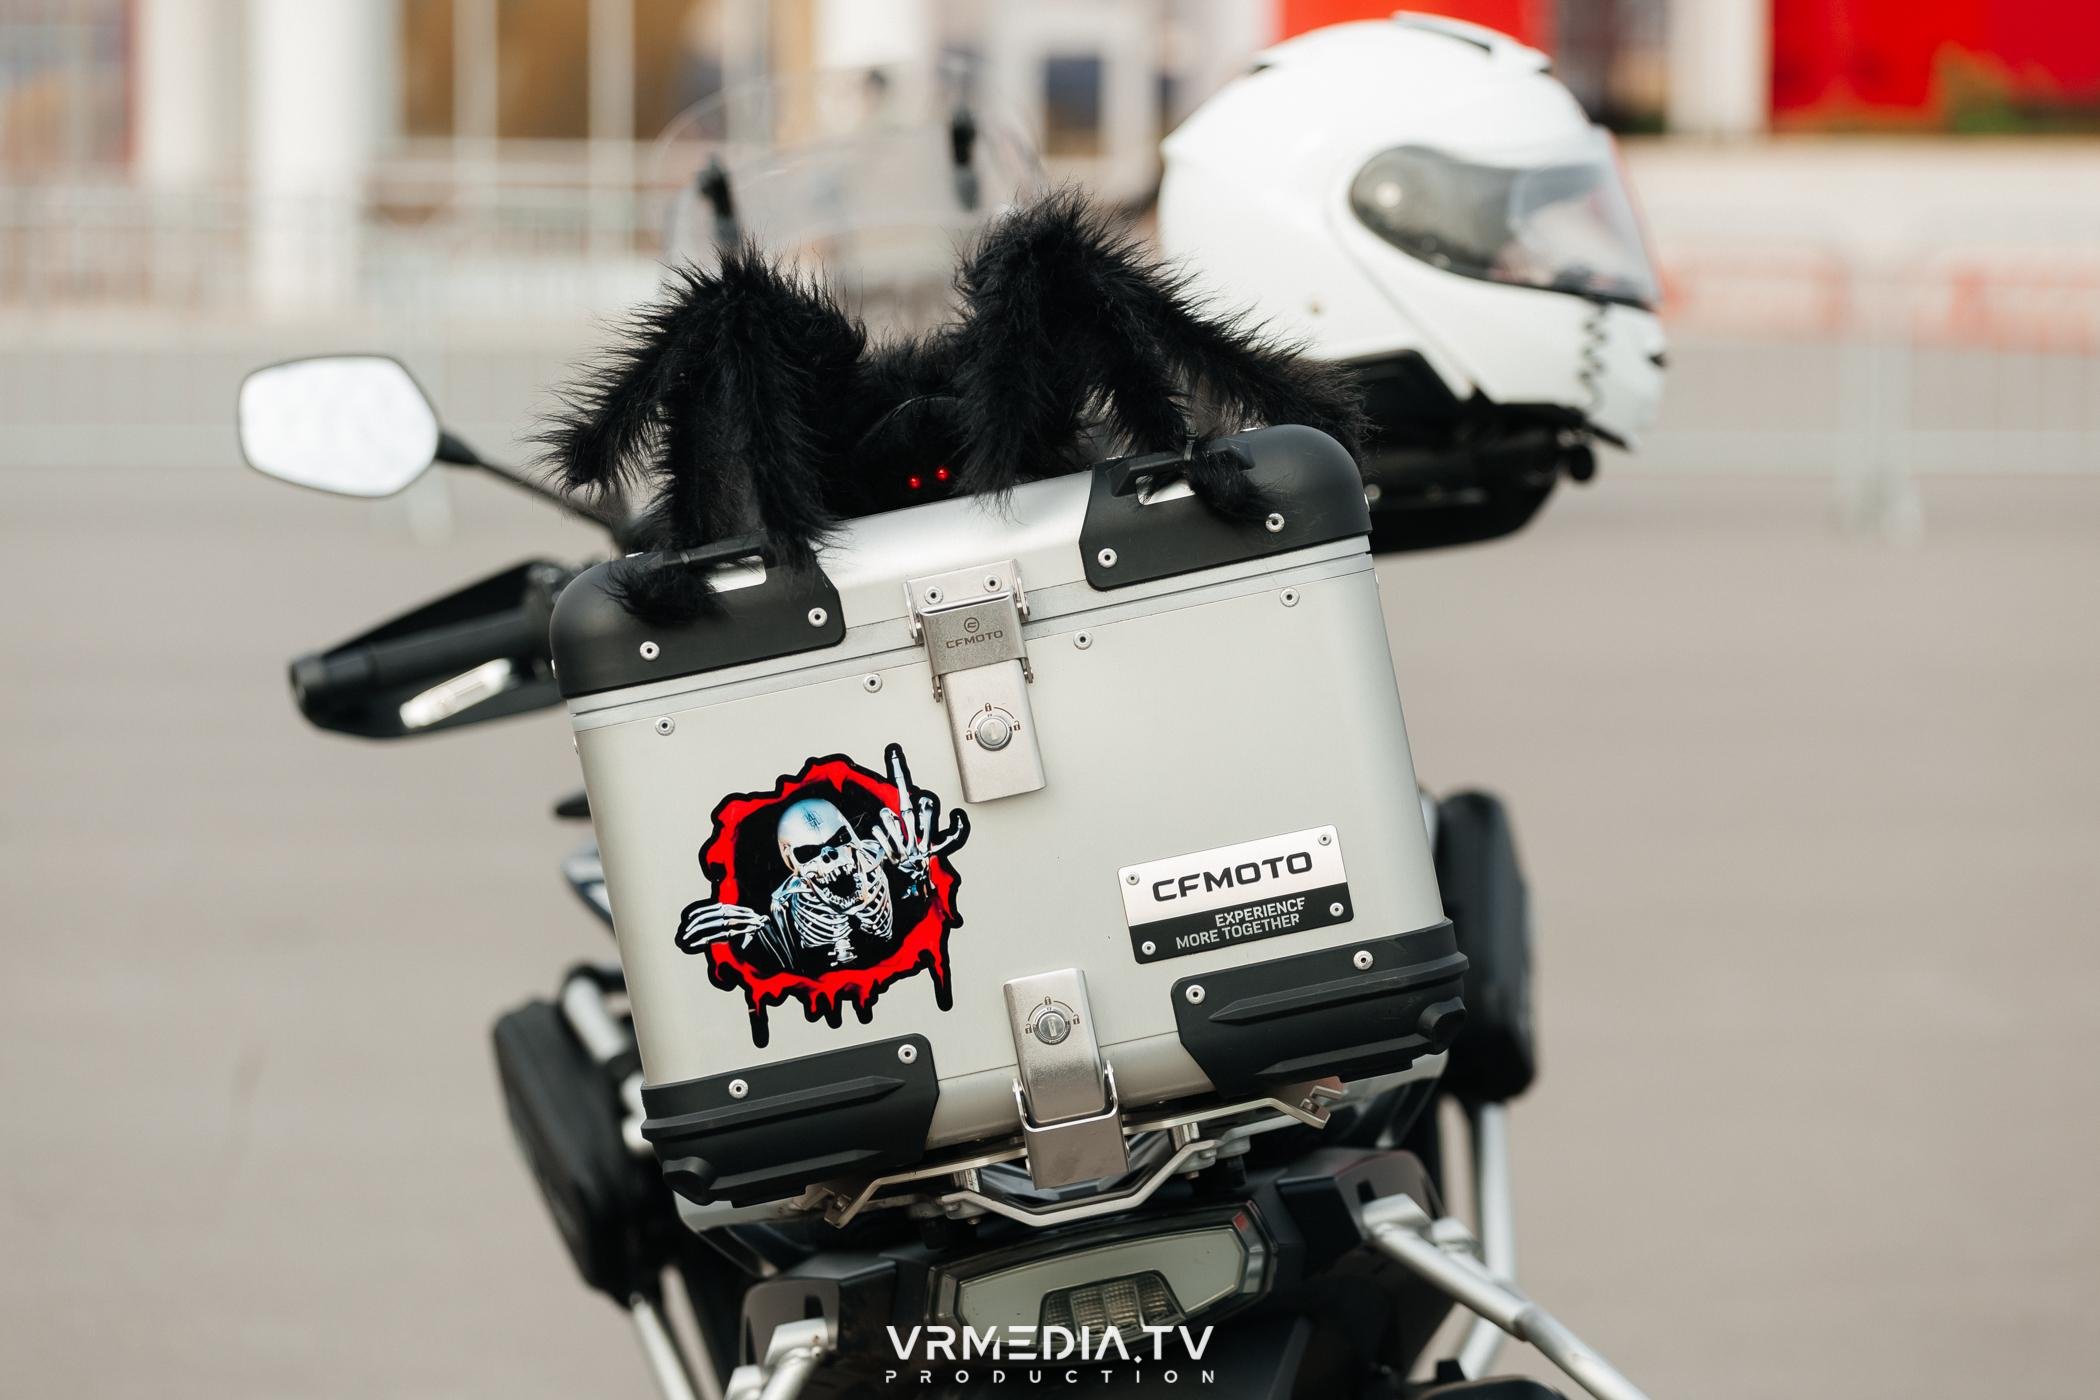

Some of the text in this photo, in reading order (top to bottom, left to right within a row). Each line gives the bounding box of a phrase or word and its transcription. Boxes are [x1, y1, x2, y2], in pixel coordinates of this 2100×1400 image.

[946, 631, 1004, 649] CFMOTO
[1152, 851, 1313, 902] CFMOTO
[1214, 897, 1306, 927] EXPERIENCE
[1175, 913, 1300, 950] MORE TOGETHER
